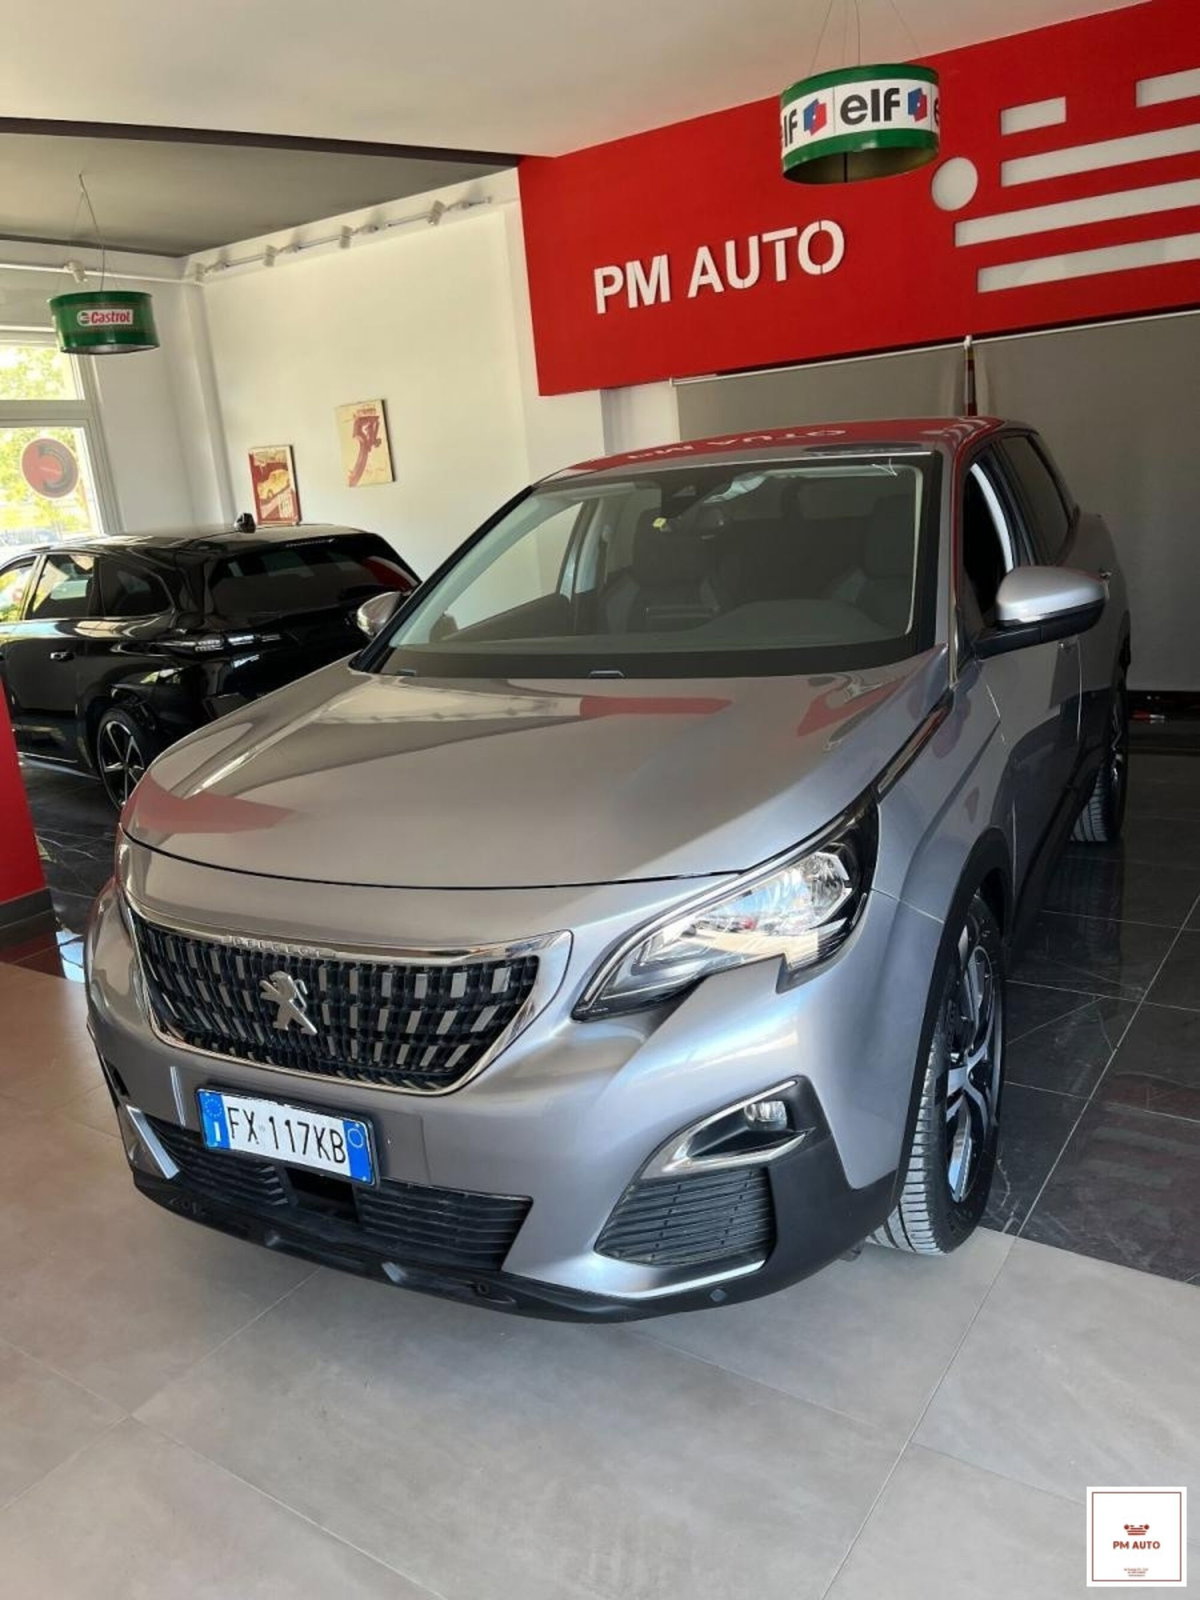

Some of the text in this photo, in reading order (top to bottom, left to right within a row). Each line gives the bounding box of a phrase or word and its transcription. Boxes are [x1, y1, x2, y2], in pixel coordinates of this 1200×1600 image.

[840, 87, 900, 126] elf
[593, 219, 845, 314] PM AUTO
[91, 310, 131, 324] Castrol
[226, 1106, 347, 1164] FX 117KB
